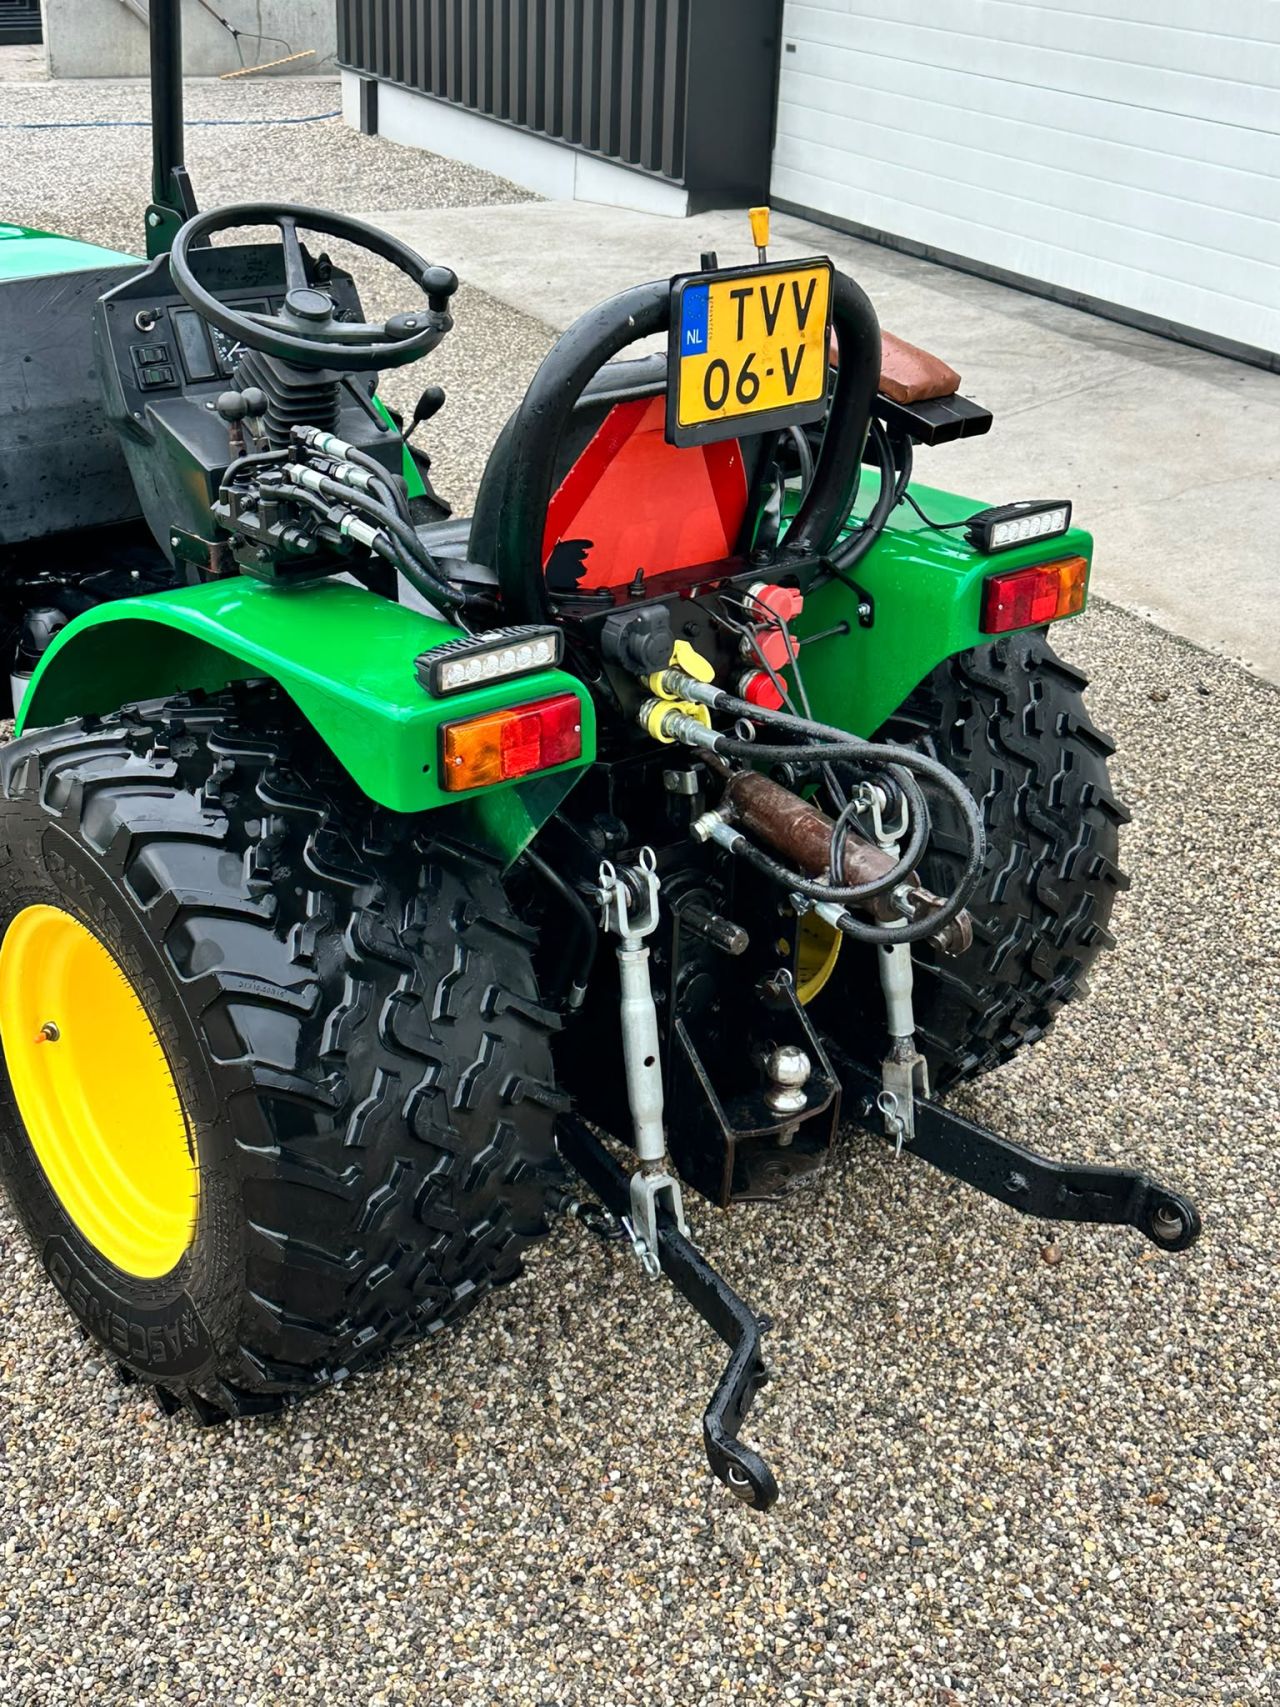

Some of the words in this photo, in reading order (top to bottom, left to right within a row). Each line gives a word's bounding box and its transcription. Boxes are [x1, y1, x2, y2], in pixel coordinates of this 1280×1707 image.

[686, 329, 702, 345] NL
[730, 278, 817, 341] TVV
[703, 344, 806, 411] 06-V
[51, 1252, 184, 1364] ASCENSO
